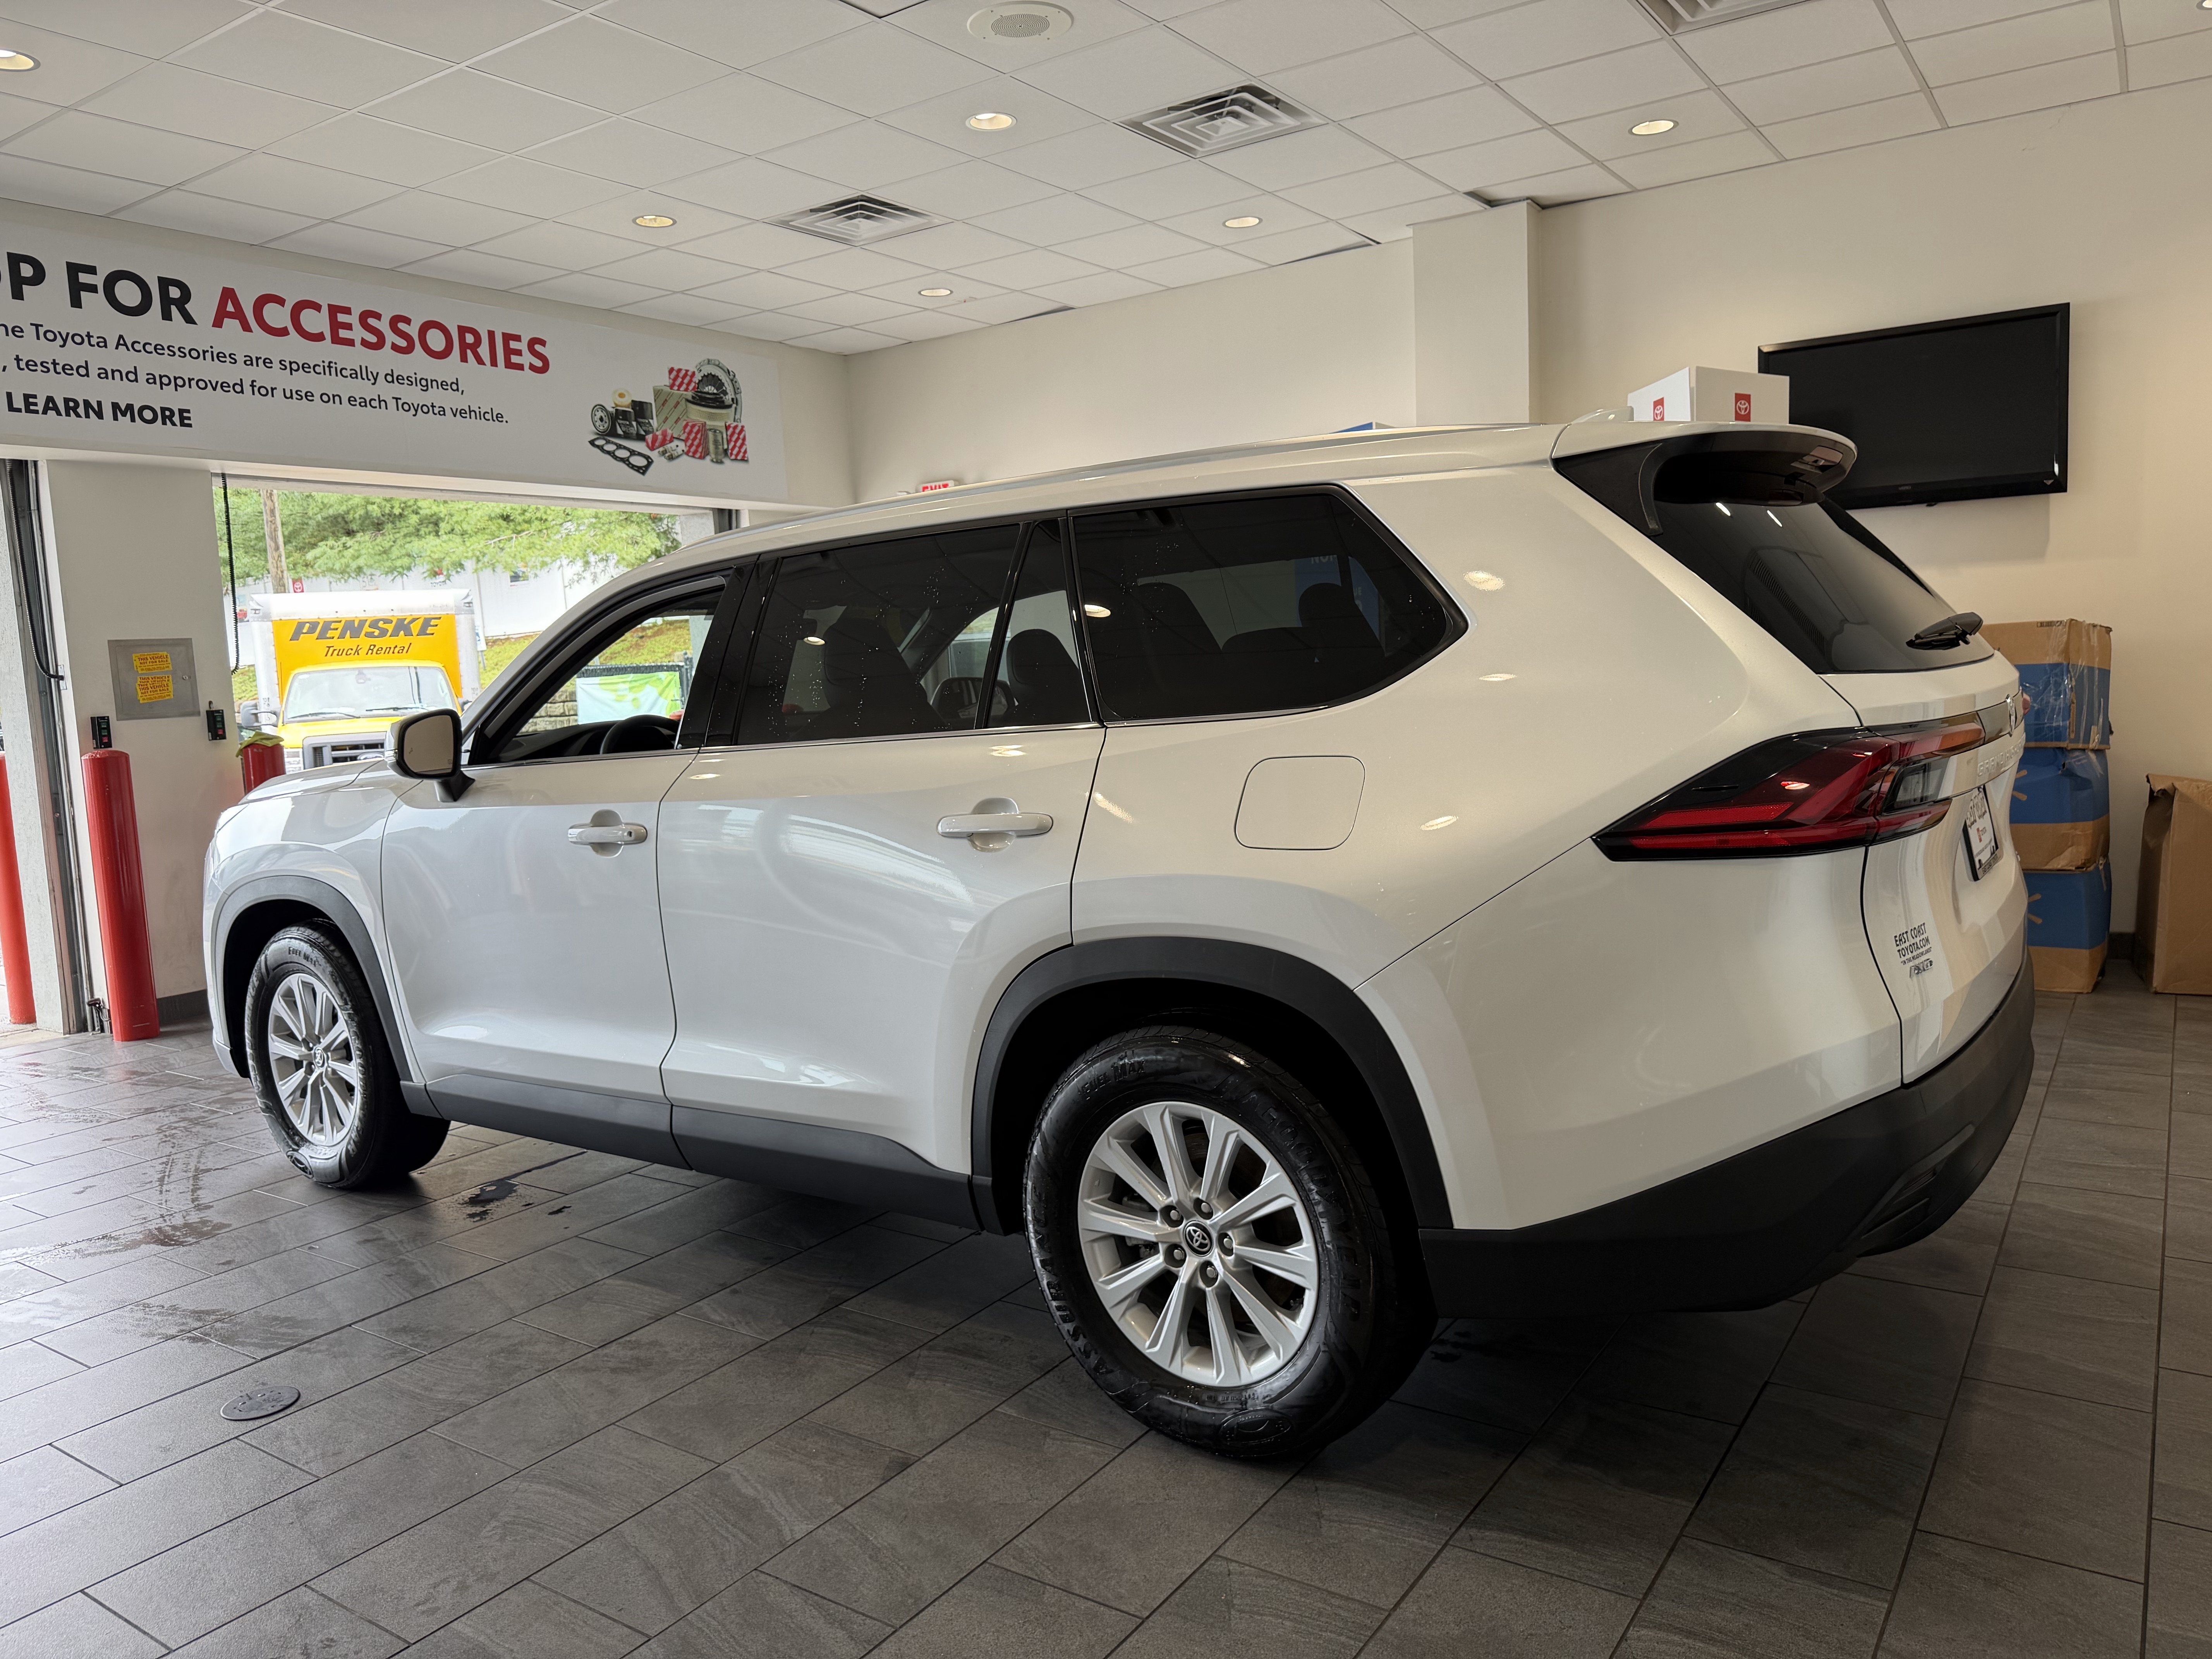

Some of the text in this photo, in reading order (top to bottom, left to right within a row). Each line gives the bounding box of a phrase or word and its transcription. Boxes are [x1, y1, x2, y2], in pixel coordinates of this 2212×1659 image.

[0, 251, 550, 374] P FOR ACCESSORIES
[30, 322, 108, 348] Toyota
[115, 334, 237, 364] Accessories
[243, 354, 273, 369] are
[279, 359, 380, 385] specifically
[384, 368, 465, 395] designed,
[14, 354, 90, 378] tested
[97, 366, 139, 383] and
[145, 372, 244, 395] approved
[249, 380, 277, 398] for
[282, 387, 315, 402] use
[320, 392, 342, 405] on
[347, 394, 388, 410] each
[392, 396, 446, 417] Toyota
[450, 405, 509, 424] vehicle.
[6, 391, 193, 428] LEARN MORE
[289, 617, 443, 641] PENSKE
[325, 642, 412, 657] Truck Rental
[1894, 922, 1926, 947] EAST COAST
[1897, 936, 1930, 958] TOYOTA.COM
[1111, 1060, 1146, 1082] MAX
